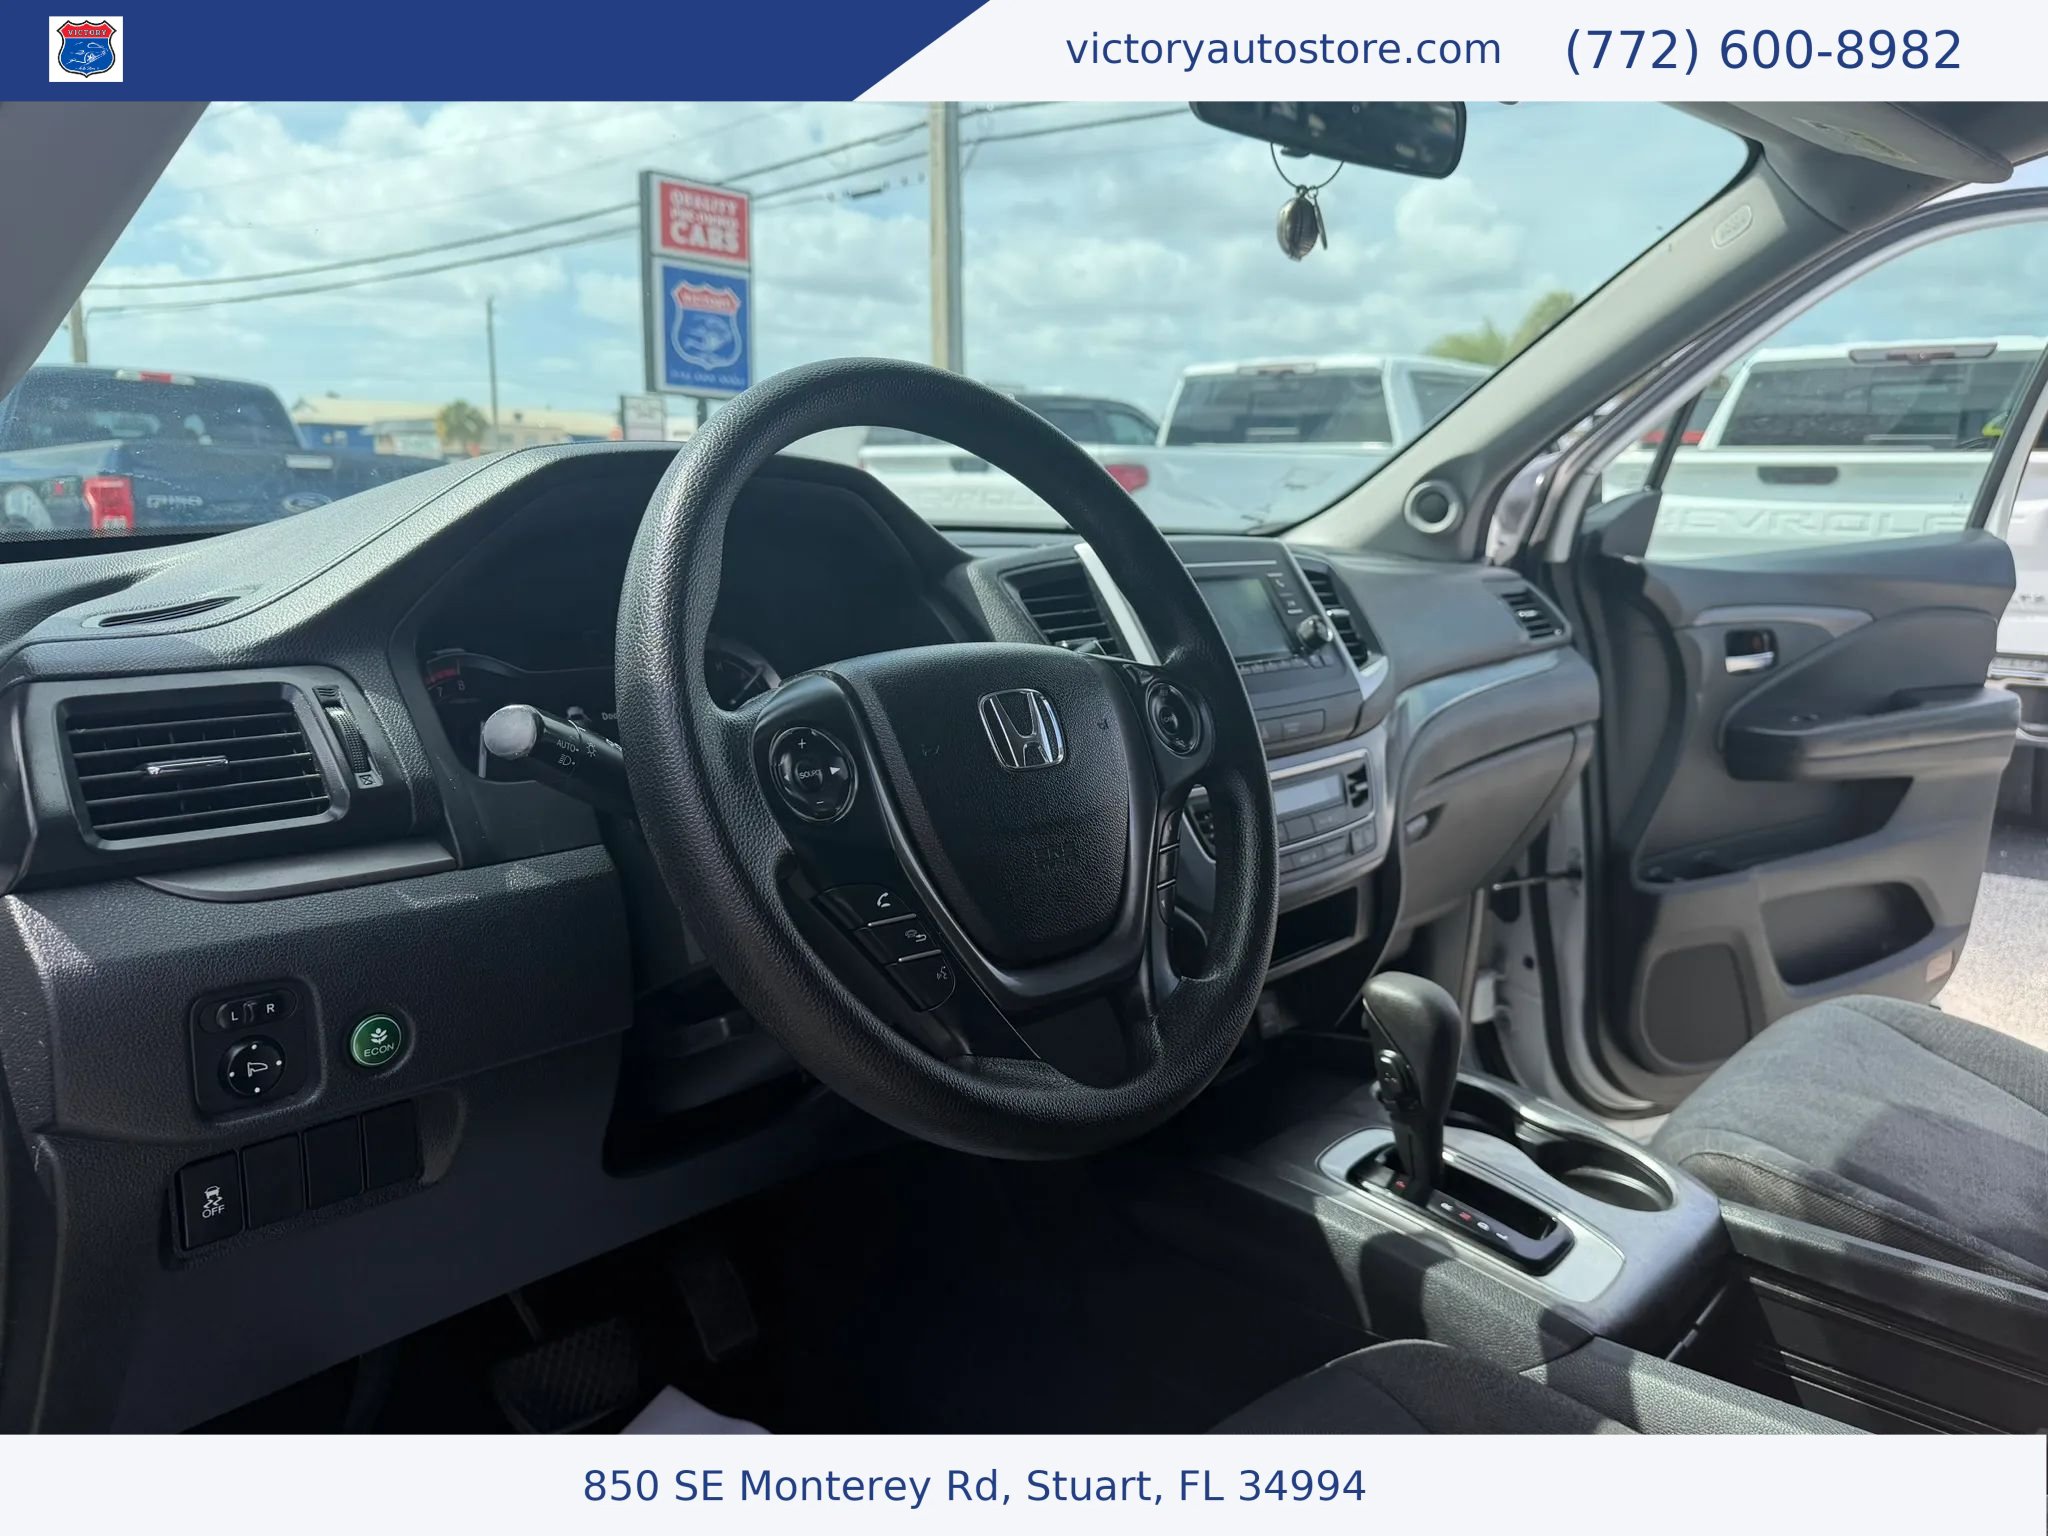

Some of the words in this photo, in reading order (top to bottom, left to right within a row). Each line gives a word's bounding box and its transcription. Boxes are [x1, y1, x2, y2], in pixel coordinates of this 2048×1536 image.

[669, 221, 740, 253] CARS
[556, 738, 576, 753] AUTO
[231, 1011, 238, 1021] L
[266, 1003, 275, 1014] R
[363, 1043, 395, 1057] ECON
[201, 1204, 225, 1219] OFF
